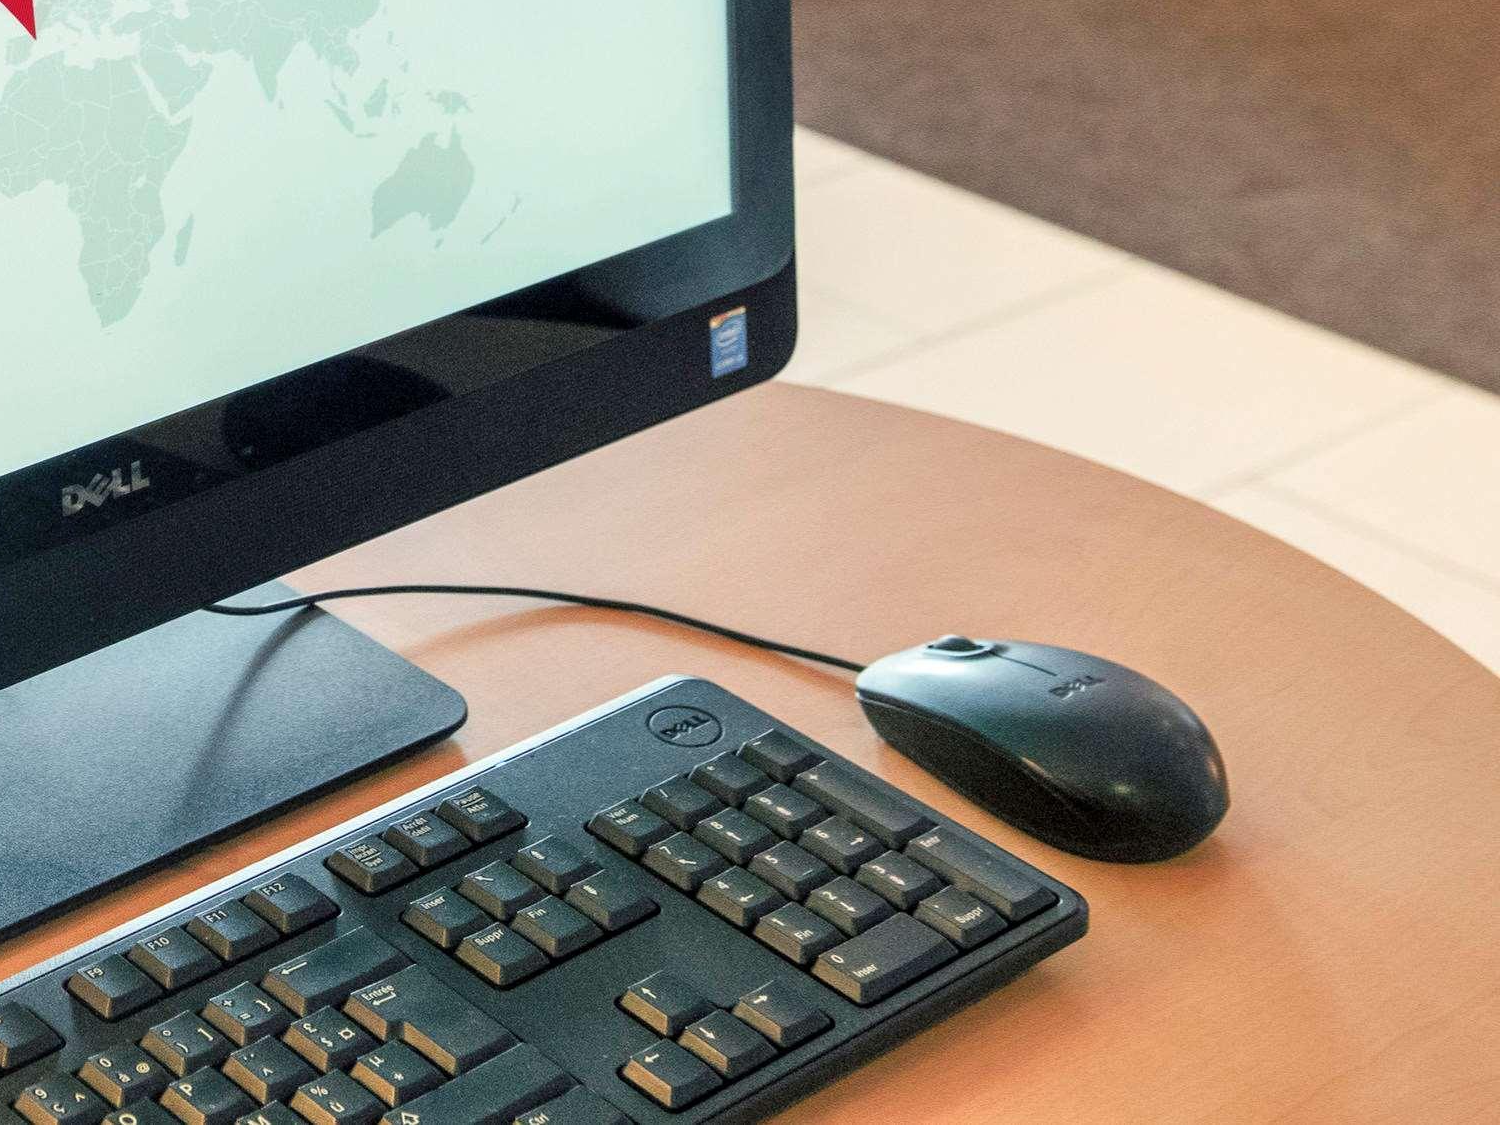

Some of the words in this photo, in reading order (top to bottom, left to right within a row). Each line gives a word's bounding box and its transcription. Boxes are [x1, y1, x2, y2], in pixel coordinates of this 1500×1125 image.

[62, 460, 150, 516] DELL
[660, 715, 713, 741] DELL
[815, 830, 830, 839] 6
[659, 845, 672, 855] 7
[765, 855, 778, 864] 5
[871, 865, 886, 874] 3
[261, 883, 286, 896] F12
[717, 881, 730, 889] 4
[420, 895, 446, 910] Inser
[822, 891, 837, 901] 2
[205, 910, 228, 923] F11
[527, 908, 546, 920] Fin
[954, 906, 984, 924] Suppr
[474, 928, 505, 946] Suppr
[794, 929, 814, 940] Fin
[146, 936, 170, 951] F10
[830, 954, 845, 964] 0
[86, 967, 104, 979] F9
[853, 963, 878, 978] Inser
[361, 983, 395, 1001] Entrée
[34, 1088, 48, 1100] 9
[179, 1082, 193, 1097] P
[309, 1084, 329, 1097] %
